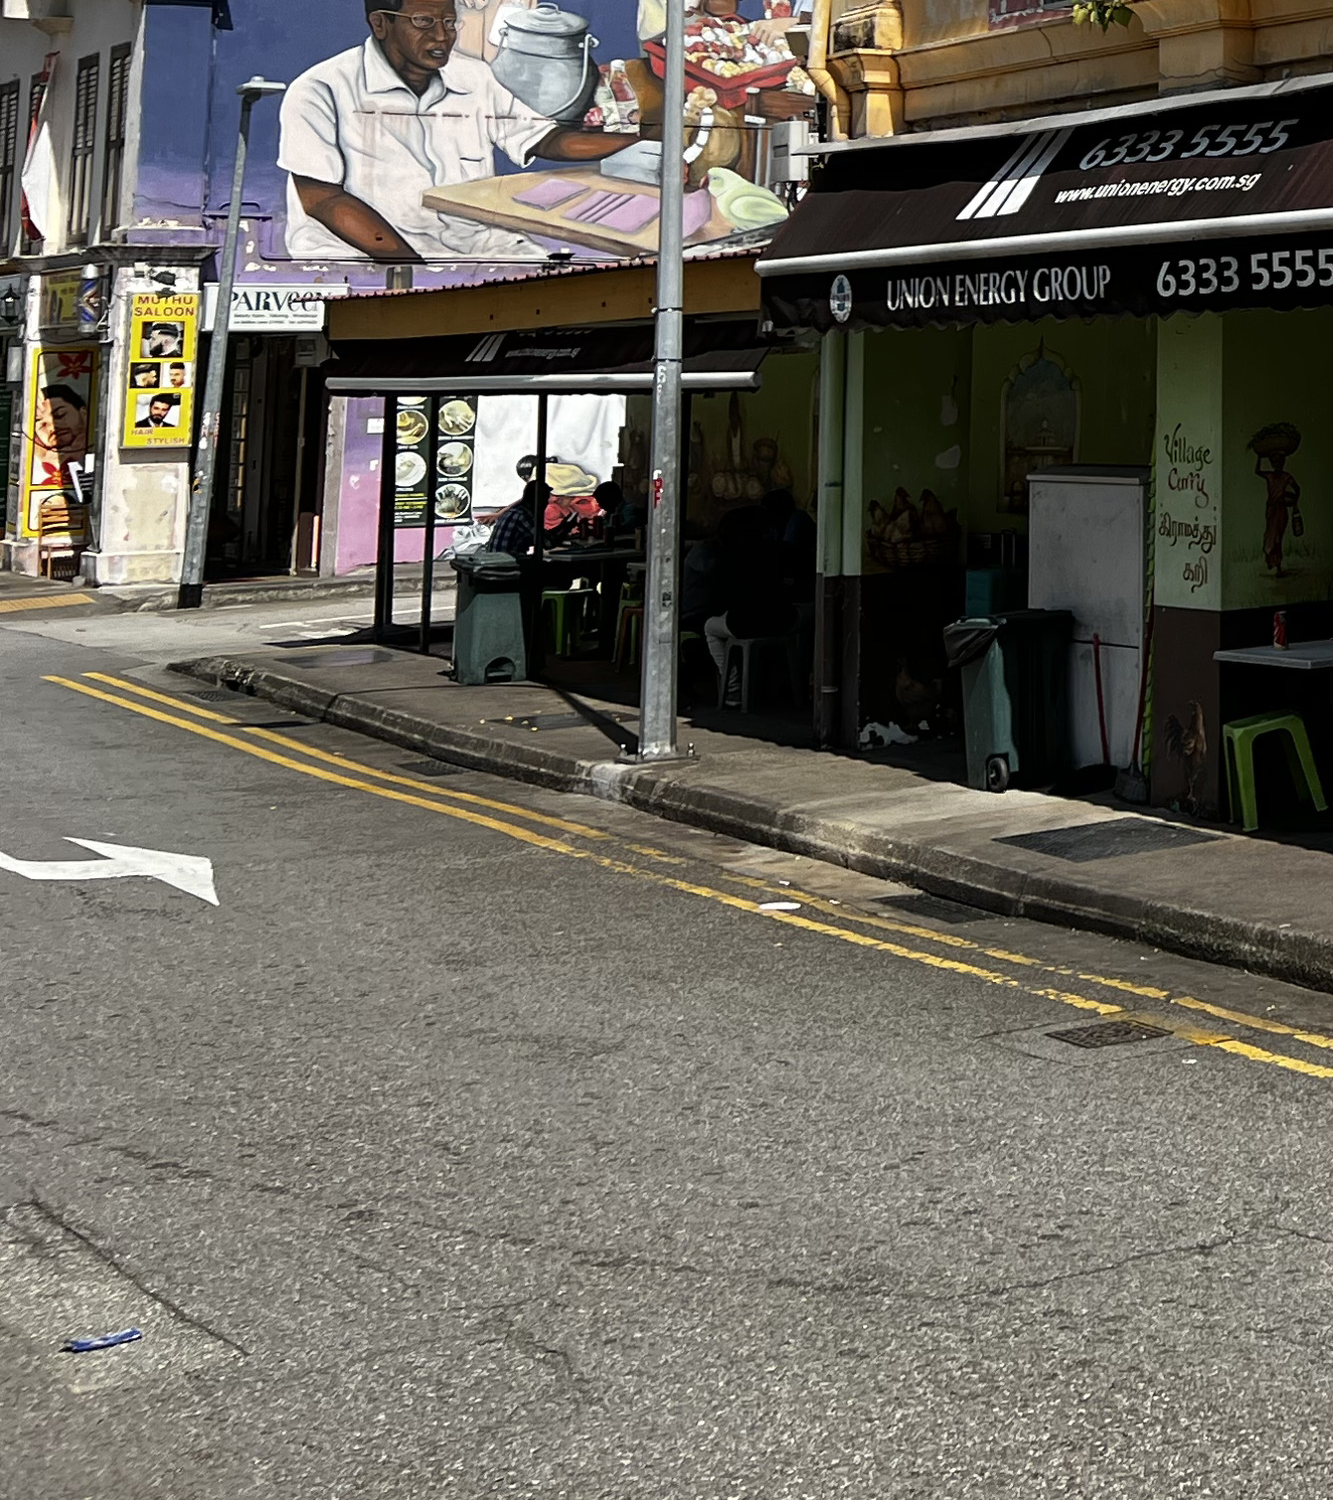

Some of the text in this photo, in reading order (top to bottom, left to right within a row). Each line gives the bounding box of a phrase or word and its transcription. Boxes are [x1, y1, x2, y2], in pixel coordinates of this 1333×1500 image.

[1079, 119, 1300, 171] 6333 5555
[1055, 172, 1262, 204] www.unionenergy.com.sg
[886, 276, 950, 311] UNION
[954, 269, 1028, 307] ENERGY
[1032, 265, 1112, 302] GROUP
[1156, 256, 1241, 298] 6333
[134, 307, 195, 316] SALOON
[1164, 423, 1213, 471] Village
